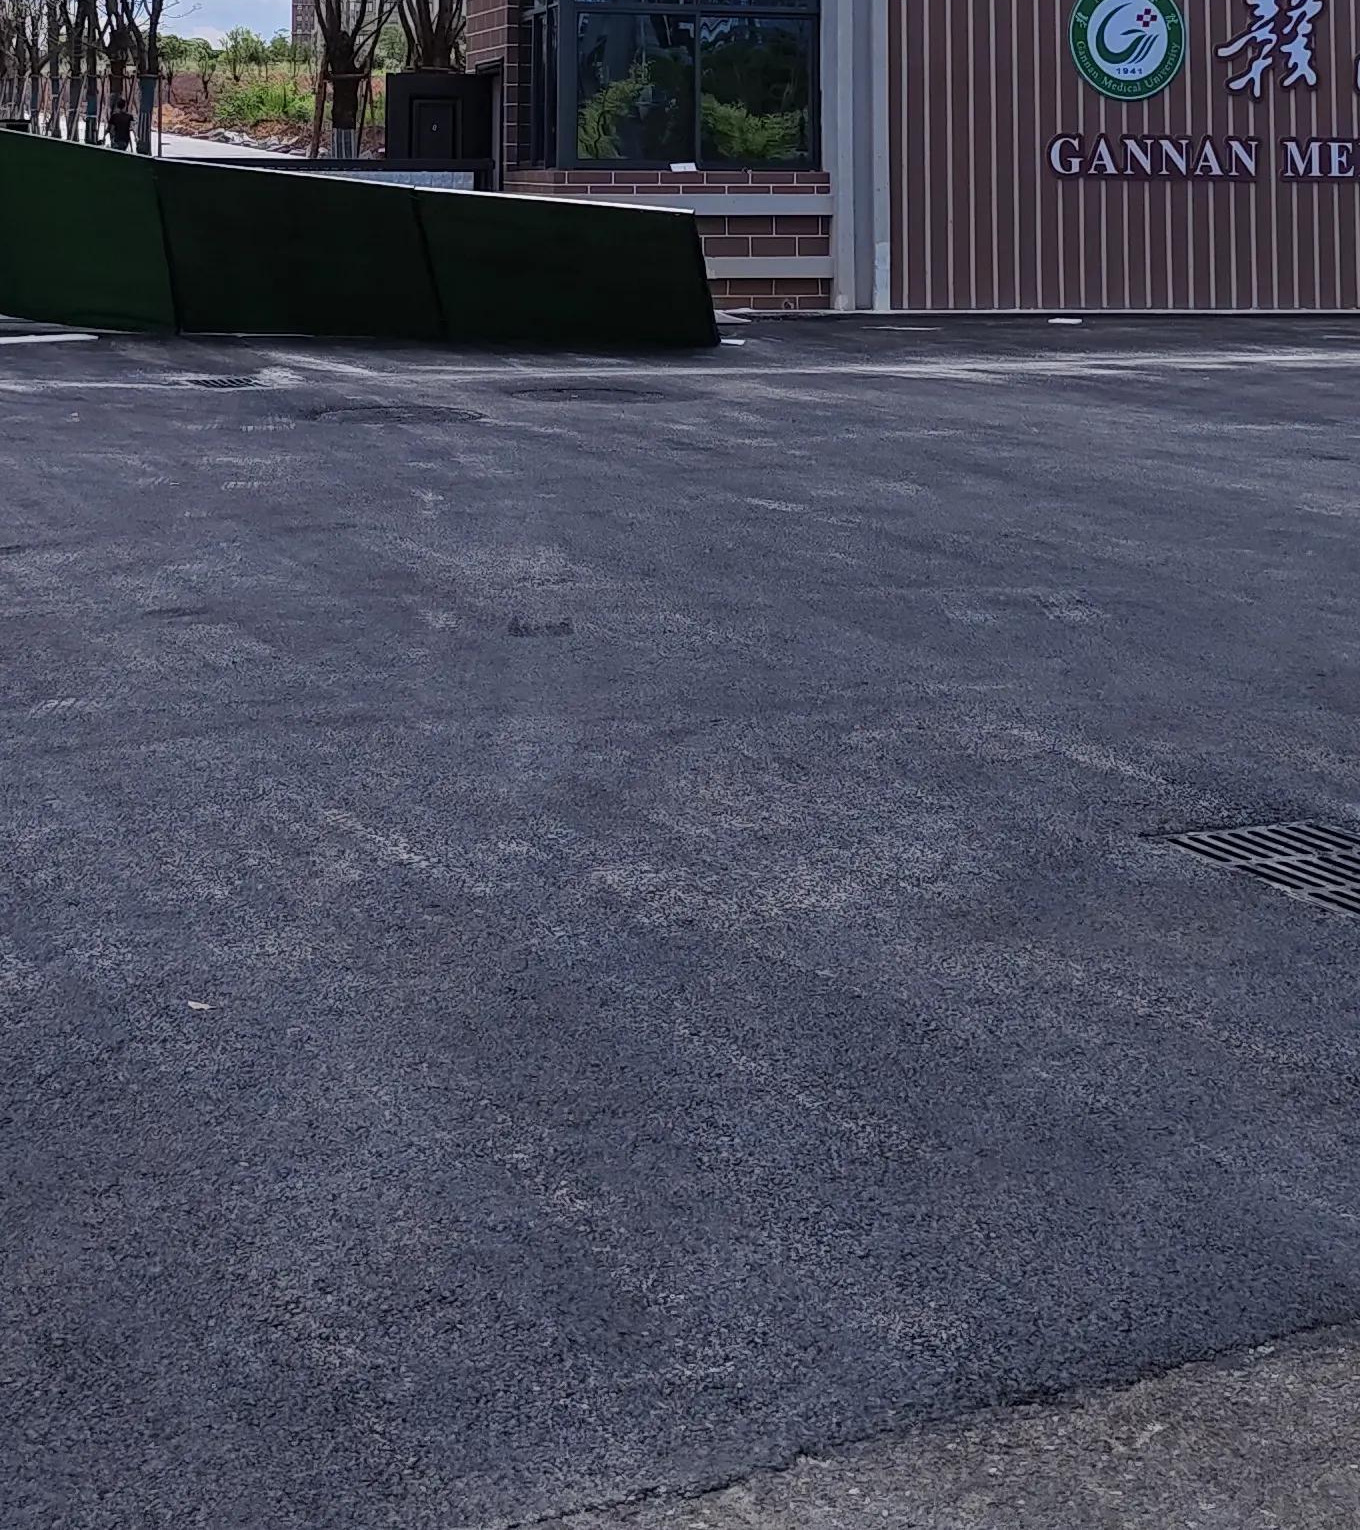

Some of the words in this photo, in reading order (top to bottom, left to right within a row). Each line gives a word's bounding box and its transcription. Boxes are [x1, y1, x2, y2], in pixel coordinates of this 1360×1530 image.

[1076, 40, 1099, 80] Gannan
[1101, 75, 1142, 93] Medical
[1143, 41, 1181, 89] University
[1115, 67, 1143, 75] 1941
[1048, 136, 1259, 176] GANNAN
